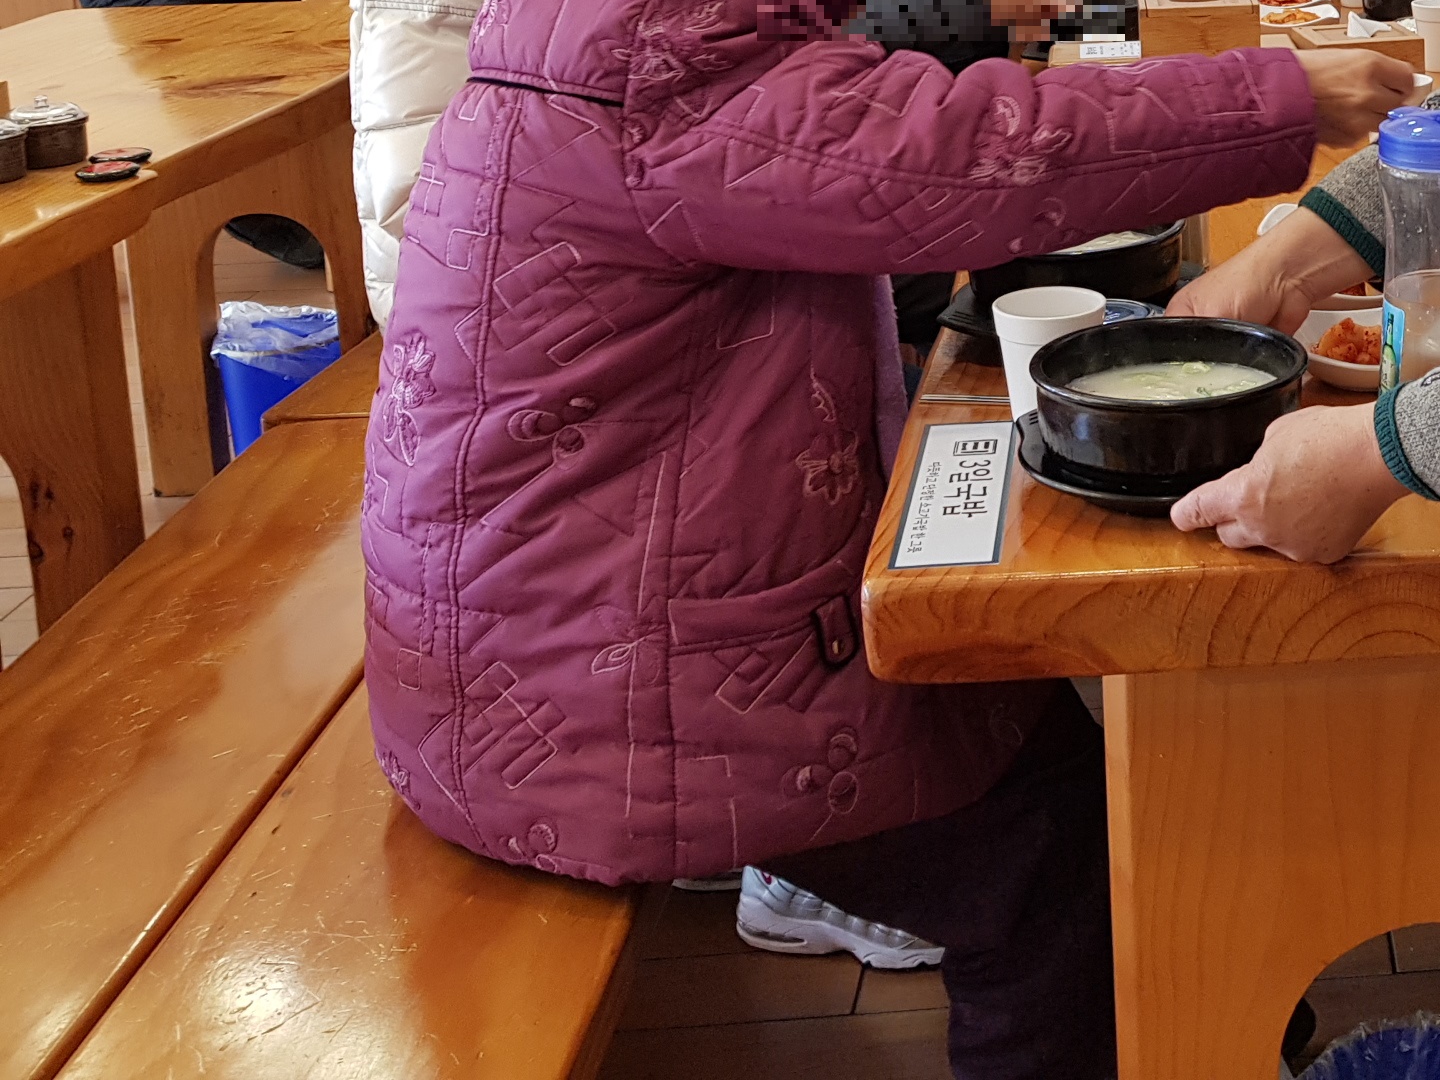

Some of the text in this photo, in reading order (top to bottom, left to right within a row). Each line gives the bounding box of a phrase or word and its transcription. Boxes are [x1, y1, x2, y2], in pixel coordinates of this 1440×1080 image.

[920, 484, 936, 500] 단정한
[942, 459, 994, 518] 3일국밥
[912, 502, 932, 531] 소고기국밥
[907, 541, 922, 553] 그릇
